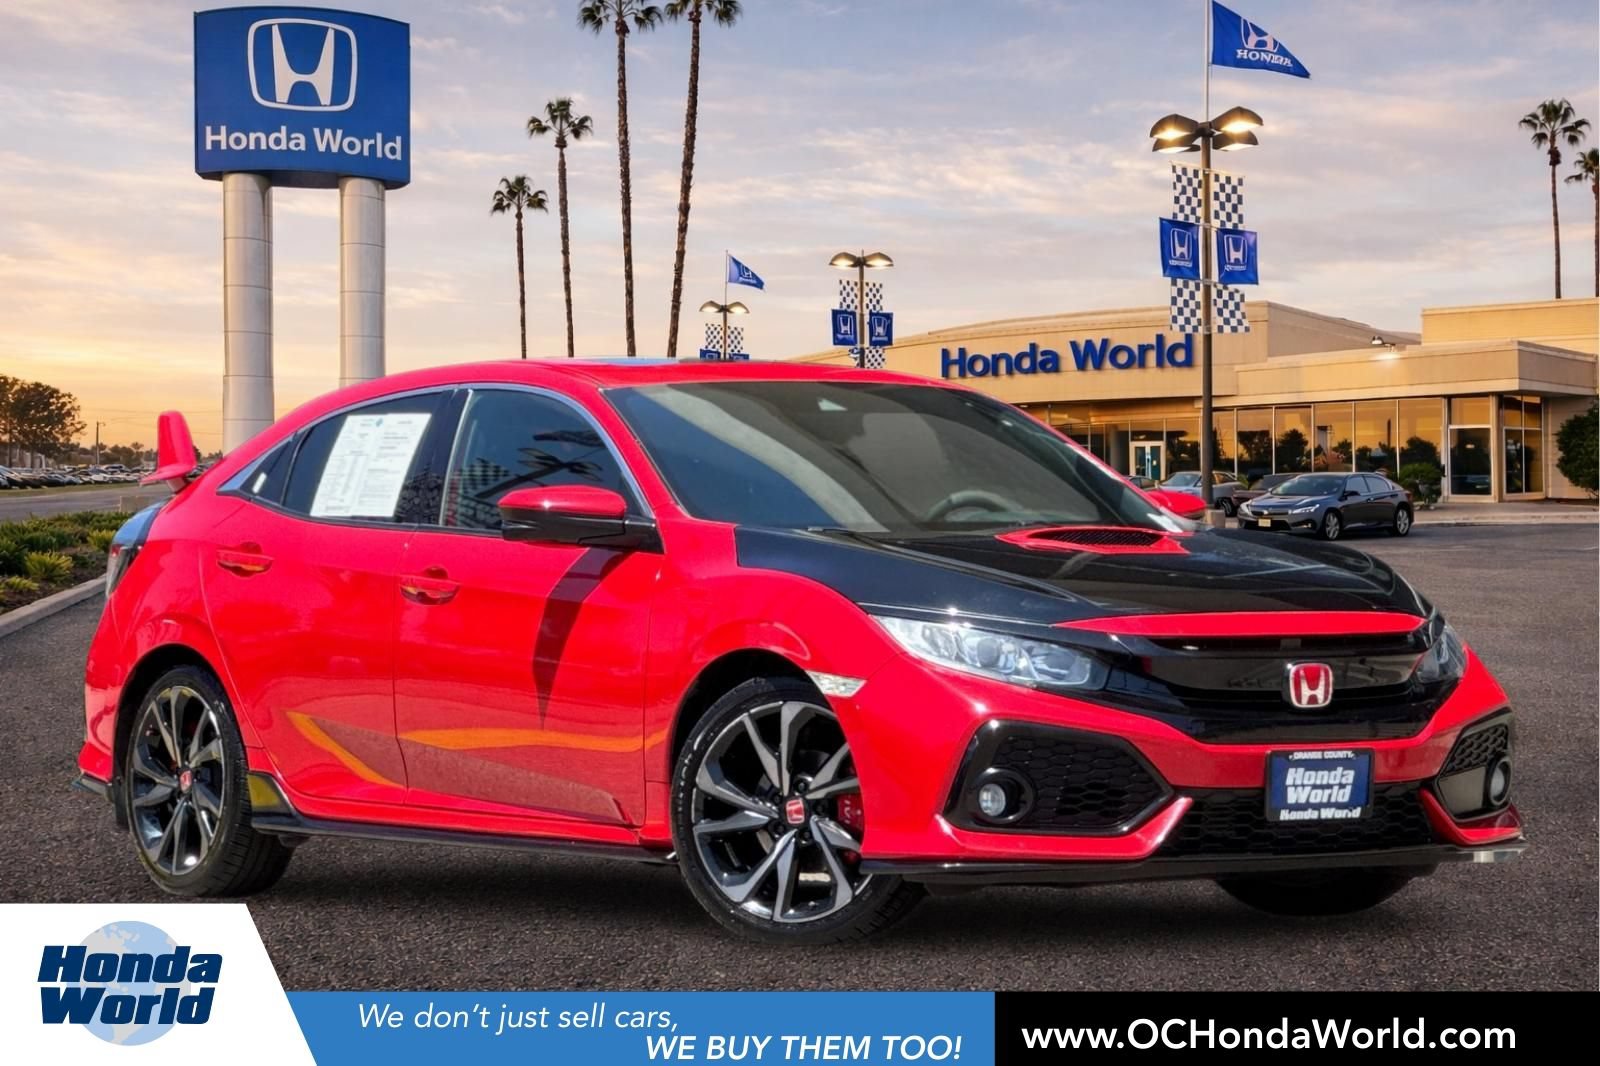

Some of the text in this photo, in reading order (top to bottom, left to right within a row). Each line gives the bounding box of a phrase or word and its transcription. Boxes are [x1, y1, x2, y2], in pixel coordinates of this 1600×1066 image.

[205, 125, 402, 160] Honda World
[941, 333, 1195, 379] Honda World
[1285, 766, 1355, 786] Honda
[1287, 785, 1352, 804] World
[1279, 808, 1319, 821] Honda
